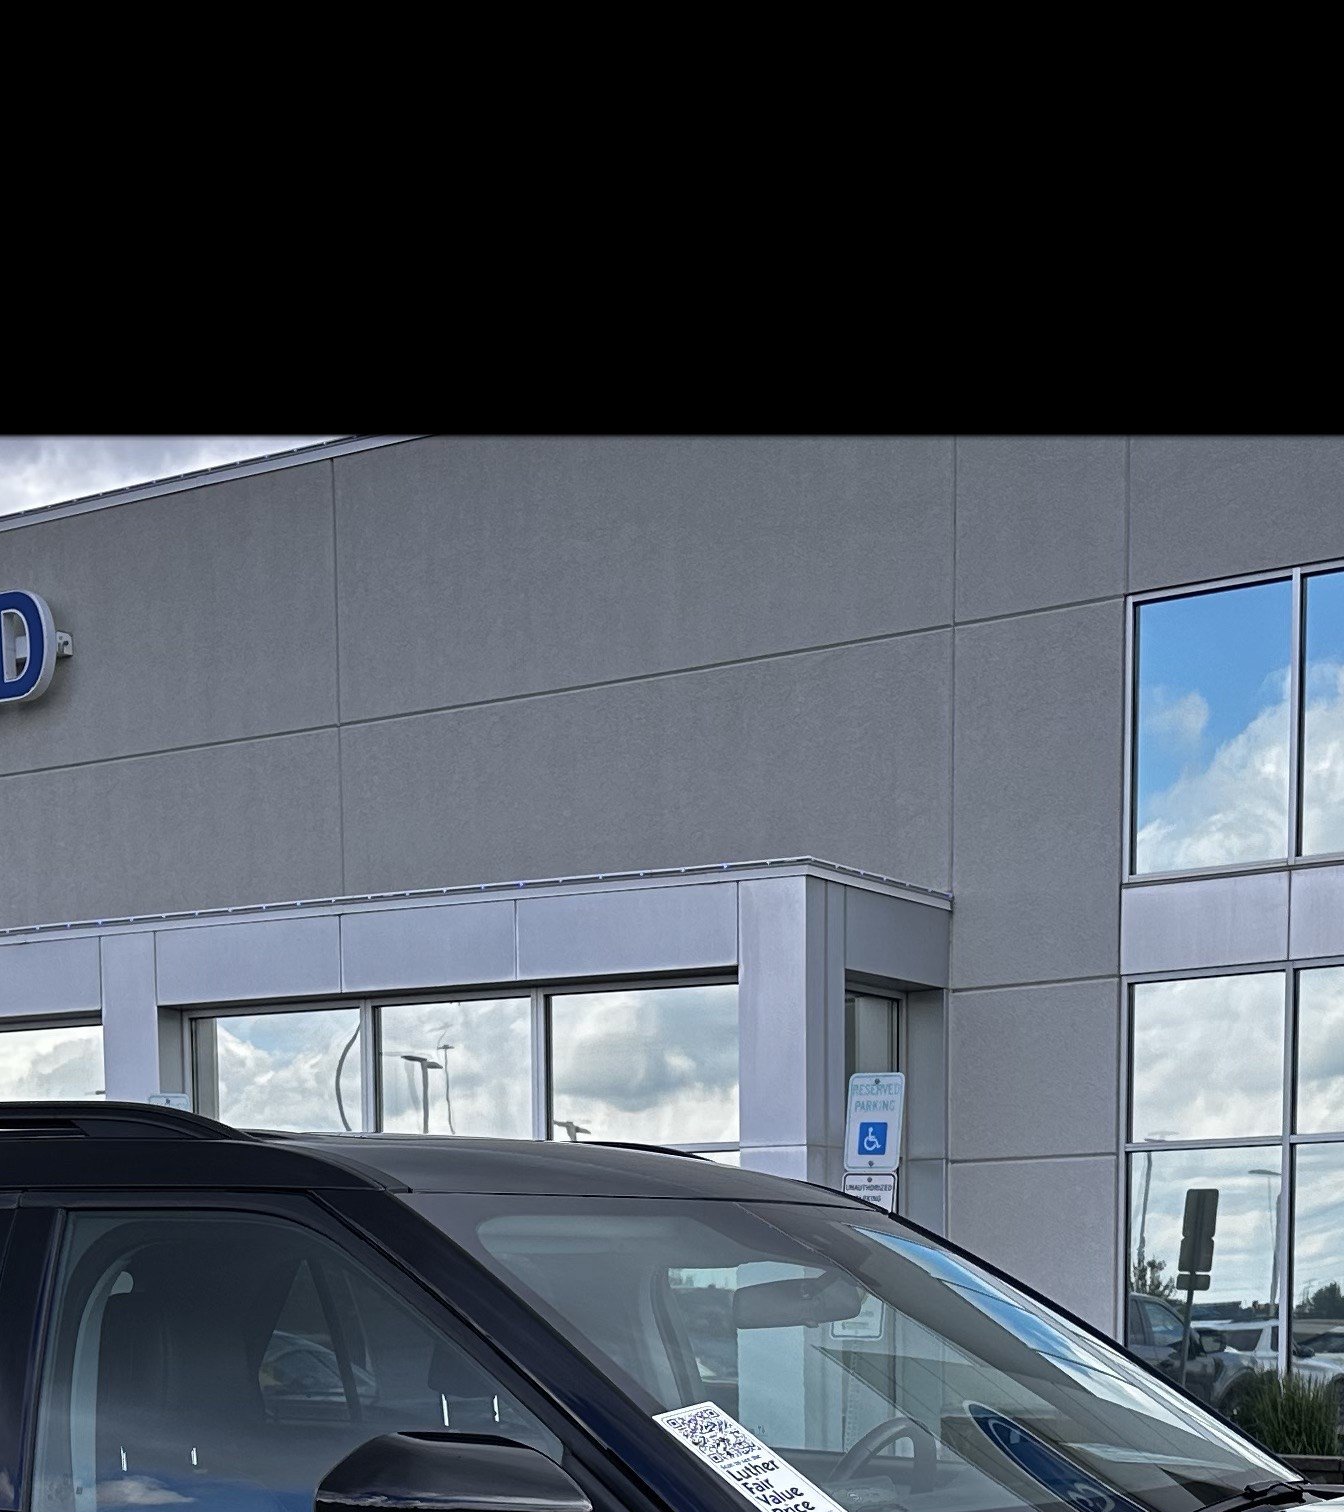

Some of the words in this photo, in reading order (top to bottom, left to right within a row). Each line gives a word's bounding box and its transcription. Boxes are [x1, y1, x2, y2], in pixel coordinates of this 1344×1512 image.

[851, 1083, 900, 1096] RESERVED
[854, 1100, 896, 1113] PARKING
[726, 1460, 779, 1482] Luther
[741, 1477, 774, 1495] Fair
[755, 1487, 804, 1506] Value
